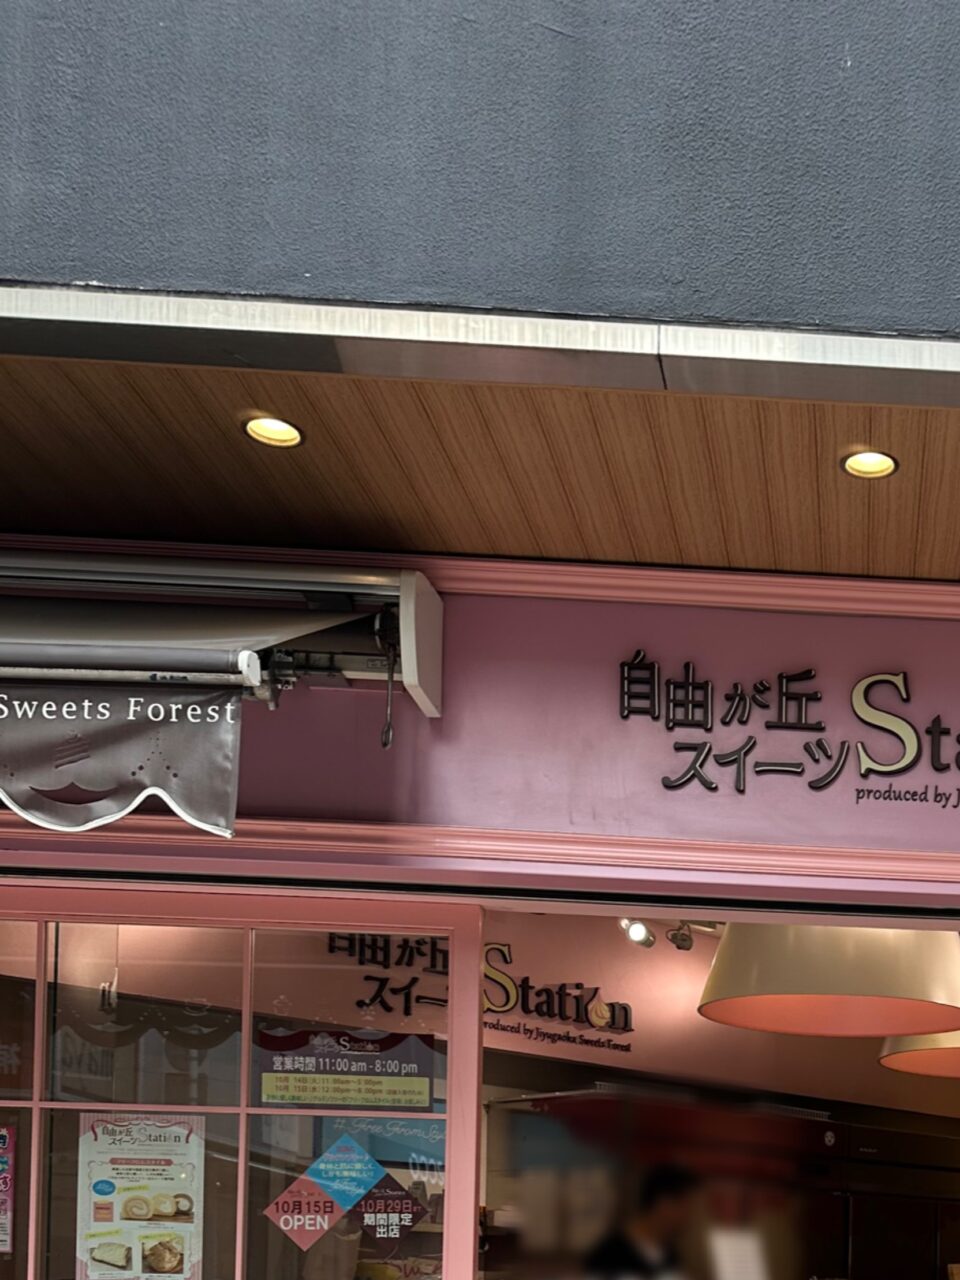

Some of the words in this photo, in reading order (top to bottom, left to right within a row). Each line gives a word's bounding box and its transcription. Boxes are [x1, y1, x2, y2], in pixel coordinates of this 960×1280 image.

[619, 649, 826, 732] 自由が丘
[0, 694, 111, 720] Sweets
[127, 697, 236, 724] Forest
[661, 736, 850, 793] スイーツ
[855, 783, 929, 804] produced
[933, 785, 952, 808] by
[483, 1018, 521, 1034] roduced
[523, 1023, 534, 1039] by
[318, 1057, 350, 1072] 11:00
[350, 1060, 367, 1072] am
[375, 1059, 400, 1073] 8:00
[401, 1062, 418, 1075] pm
[274, 1200, 334, 1214] 10月15日
[279, 1215, 329, 1230] OPEN
[363, 1213, 413, 1226] 期間限定
[375, 1225, 400, 1239] 出店
